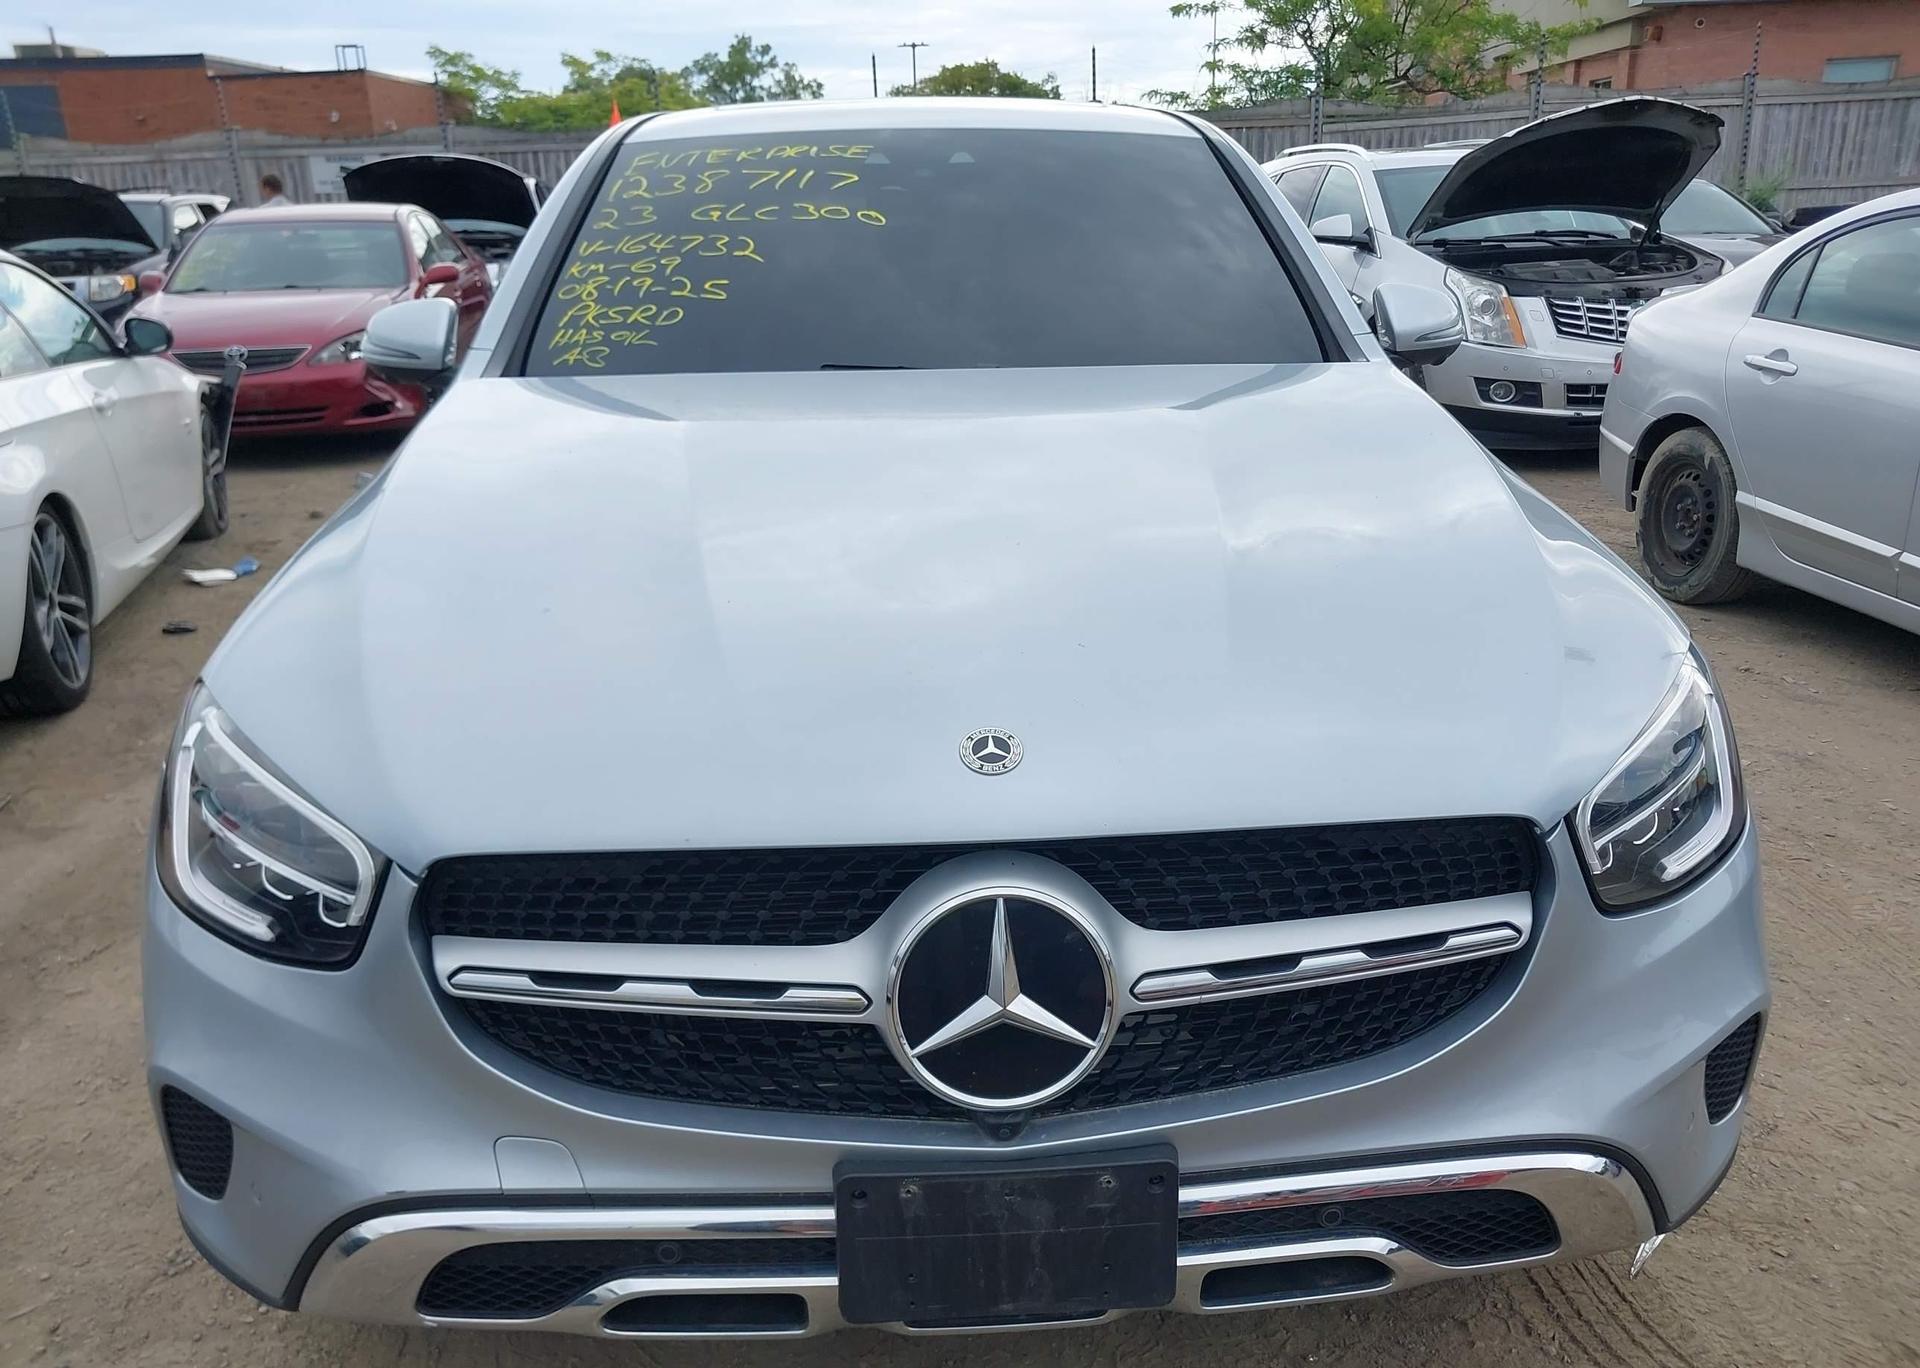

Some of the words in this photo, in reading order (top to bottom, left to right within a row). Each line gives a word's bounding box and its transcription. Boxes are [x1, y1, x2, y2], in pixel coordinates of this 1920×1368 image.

[593, 205, 658, 231] 23
[690, 202, 780, 223] GLC
[791, 203, 887, 226] 300
[548, 328, 606, 350] HAS
[610, 329, 659, 347] OIL
[982, 764, 1005, 772] BENZ
